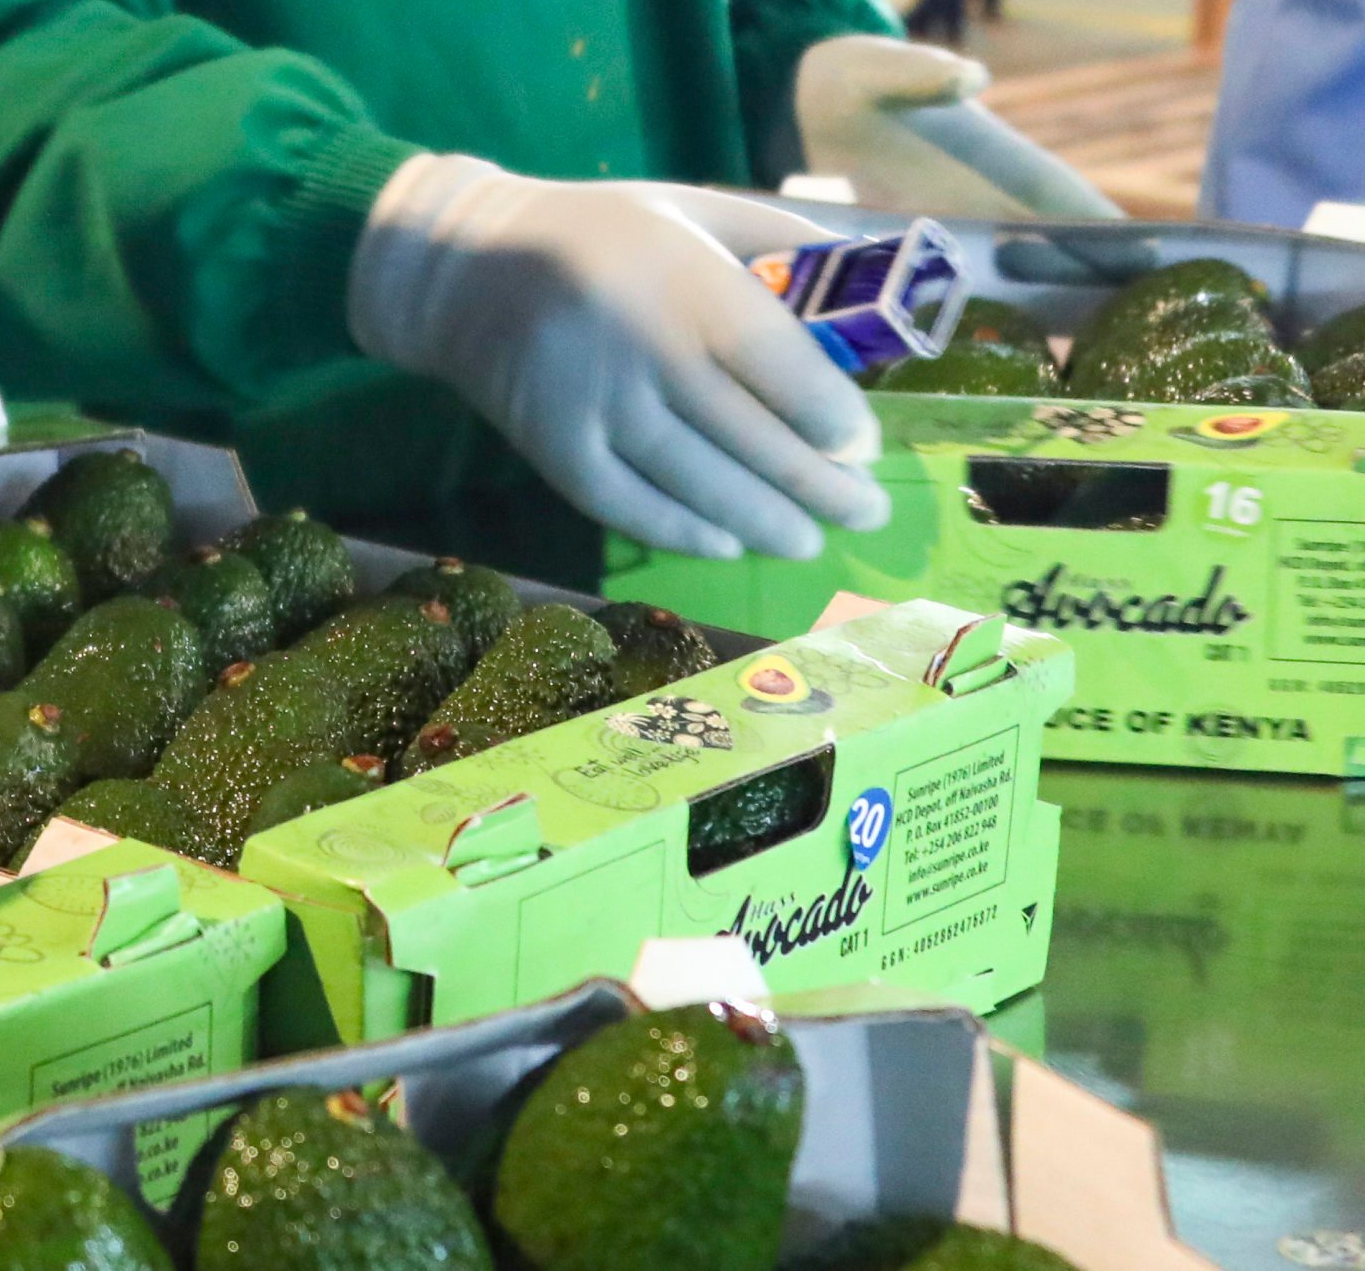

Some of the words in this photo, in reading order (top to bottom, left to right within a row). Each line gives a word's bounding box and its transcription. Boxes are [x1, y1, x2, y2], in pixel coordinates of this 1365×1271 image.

[1204, 481, 1263, 525] 16
[1001, 561, 1253, 636] Avocado
[1126, 710, 1173, 734] OF
[1186, 713, 1313, 742] KENYA
[908, 779, 942, 802] Sunripe
[943, 763, 972, 790] (1976)
[972, 749, 1005, 776] Limited
[945, 790, 958, 808] off
[959, 777, 998, 801] Naivasha
[850, 797, 886, 849] 20
[926, 821, 942, 836] Box
[906, 861, 989, 905] www.sunripe.co.ke
[840, 931, 860, 957] CAT
